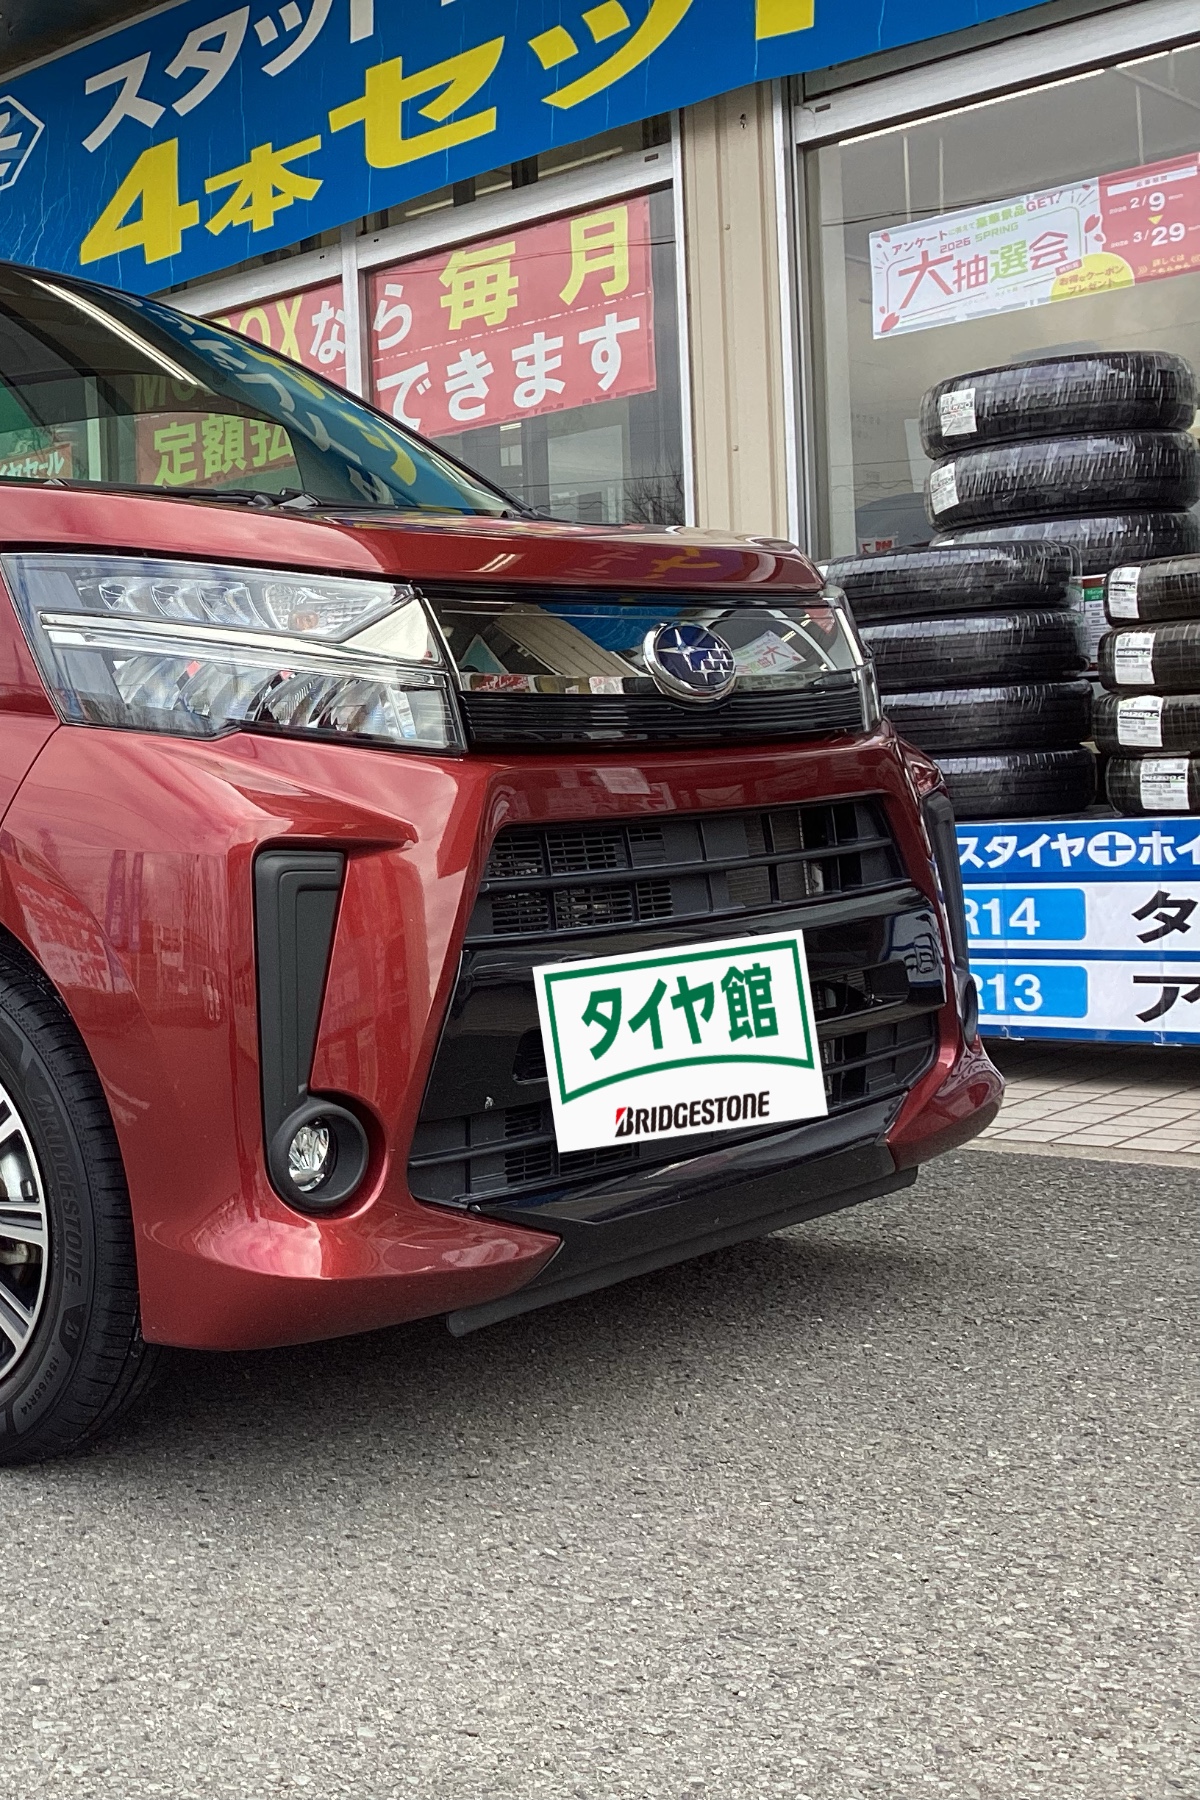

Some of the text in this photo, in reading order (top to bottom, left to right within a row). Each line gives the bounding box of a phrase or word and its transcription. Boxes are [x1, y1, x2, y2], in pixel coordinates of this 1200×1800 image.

[1130, 192, 1165, 211] 2/9
[940, 222, 1019, 254] 2026 SPRING
[1133, 223, 1185, 247] 3/29
[898, 231, 1069, 310] 大抽選会
[1068, 278, 1114, 295] プレゼント
[377, 312, 640, 430] できます
[34, 1094, 84, 1287] BRIDGESTONE
